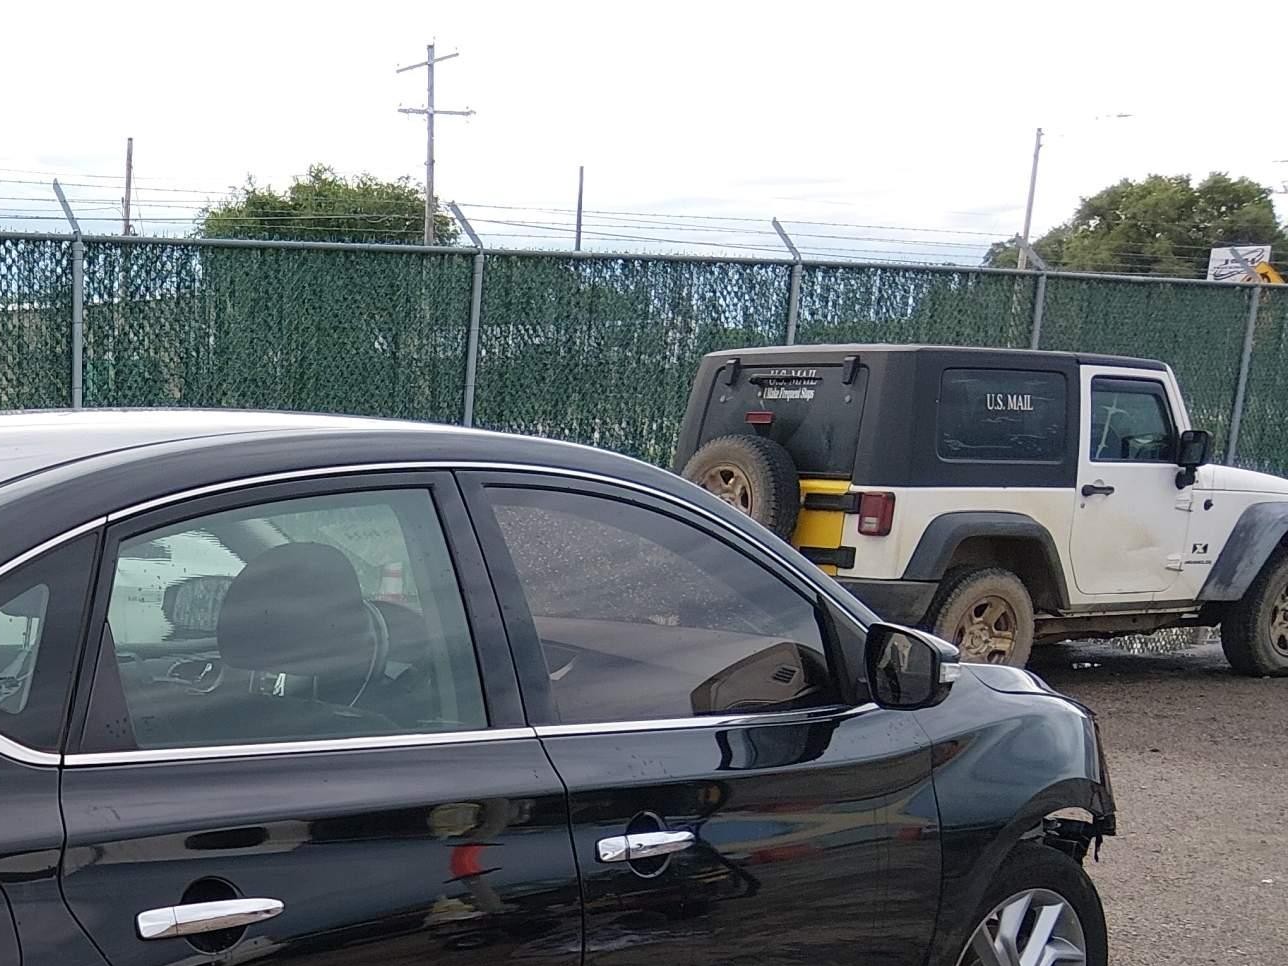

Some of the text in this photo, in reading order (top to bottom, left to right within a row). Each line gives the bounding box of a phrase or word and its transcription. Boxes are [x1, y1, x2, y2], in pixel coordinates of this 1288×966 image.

[767, 387, 779, 398] Make
[779, 387, 801, 402] Frequent
[800, 387, 815, 402] Stops
[986, 393, 1033, 410] U.S. MAIL
